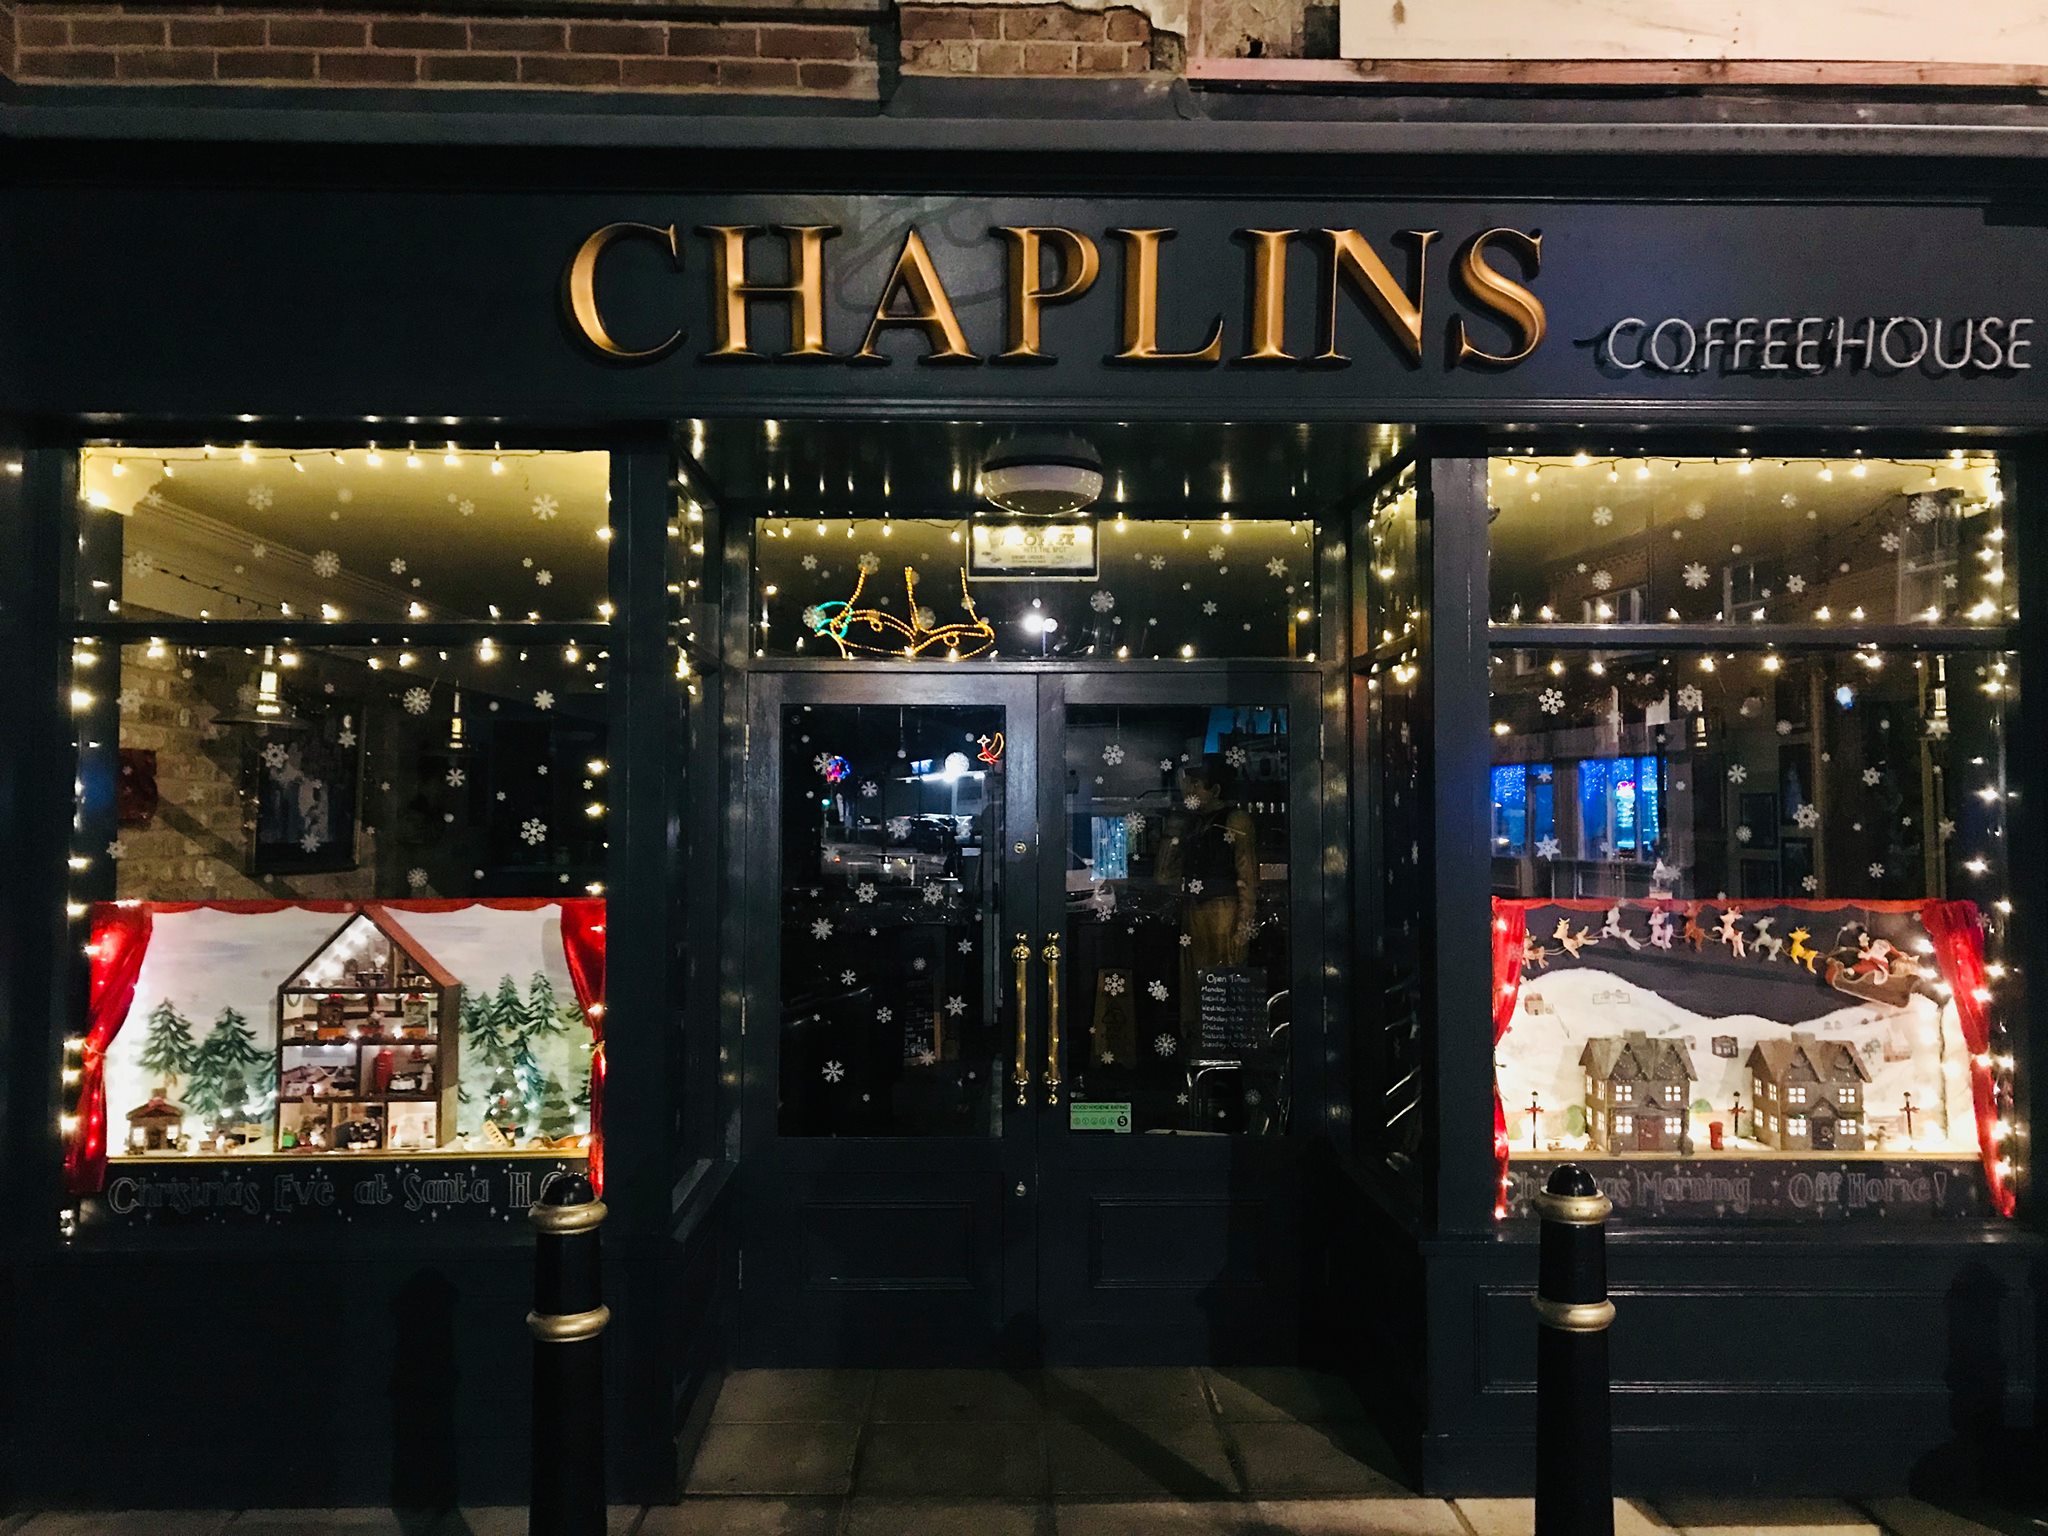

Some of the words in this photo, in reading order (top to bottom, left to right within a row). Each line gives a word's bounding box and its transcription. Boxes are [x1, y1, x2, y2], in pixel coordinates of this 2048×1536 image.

[563, 220, 1547, 366] CHAPLINS
[1206, 973, 1227, 984] Open
[1200, 985, 1226, 996] Monday
[1202, 1023, 1224, 1032] Friday
[1119, 1116, 1127, 1126] 5
[107, 1176, 261, 1216] Christmas
[273, 1173, 335, 1213] Eve
[354, 1173, 393, 1206] at
[403, 1173, 490, 1212] Santa
[1789, 1172, 1842, 1208] Off
